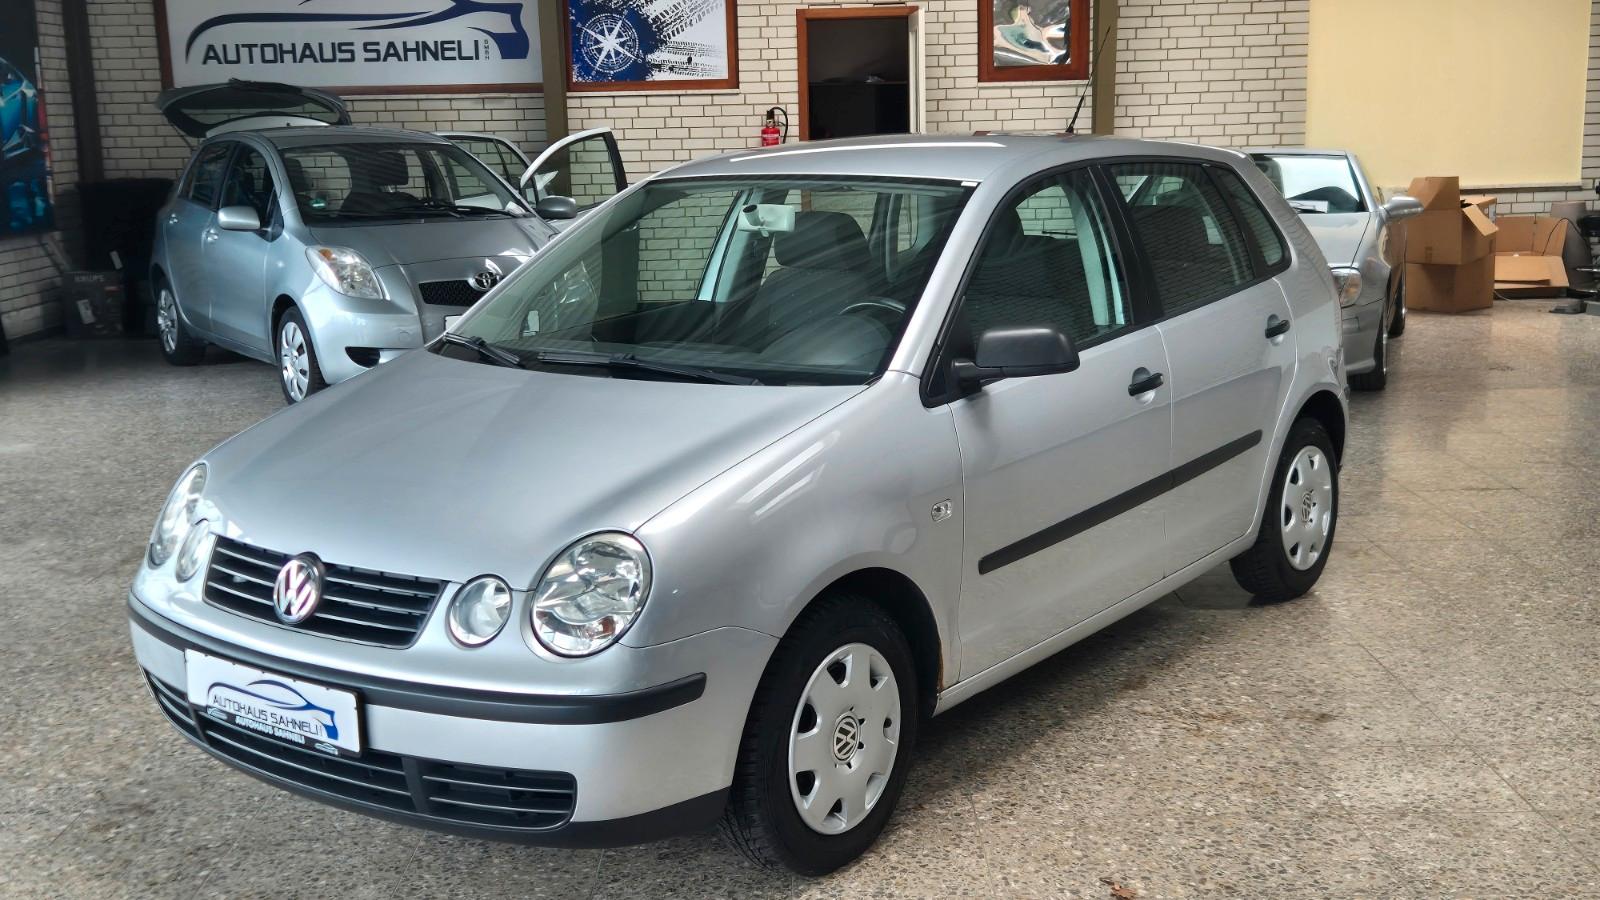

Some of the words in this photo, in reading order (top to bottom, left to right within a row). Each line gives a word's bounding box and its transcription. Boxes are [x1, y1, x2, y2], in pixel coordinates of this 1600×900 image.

[201, 42, 355, 65] AUTOHAUS
[363, 39, 479, 62] SAHNELI
[213, 694, 268, 721] AUTOHAUS
[271, 712, 320, 737] SAHNELI
